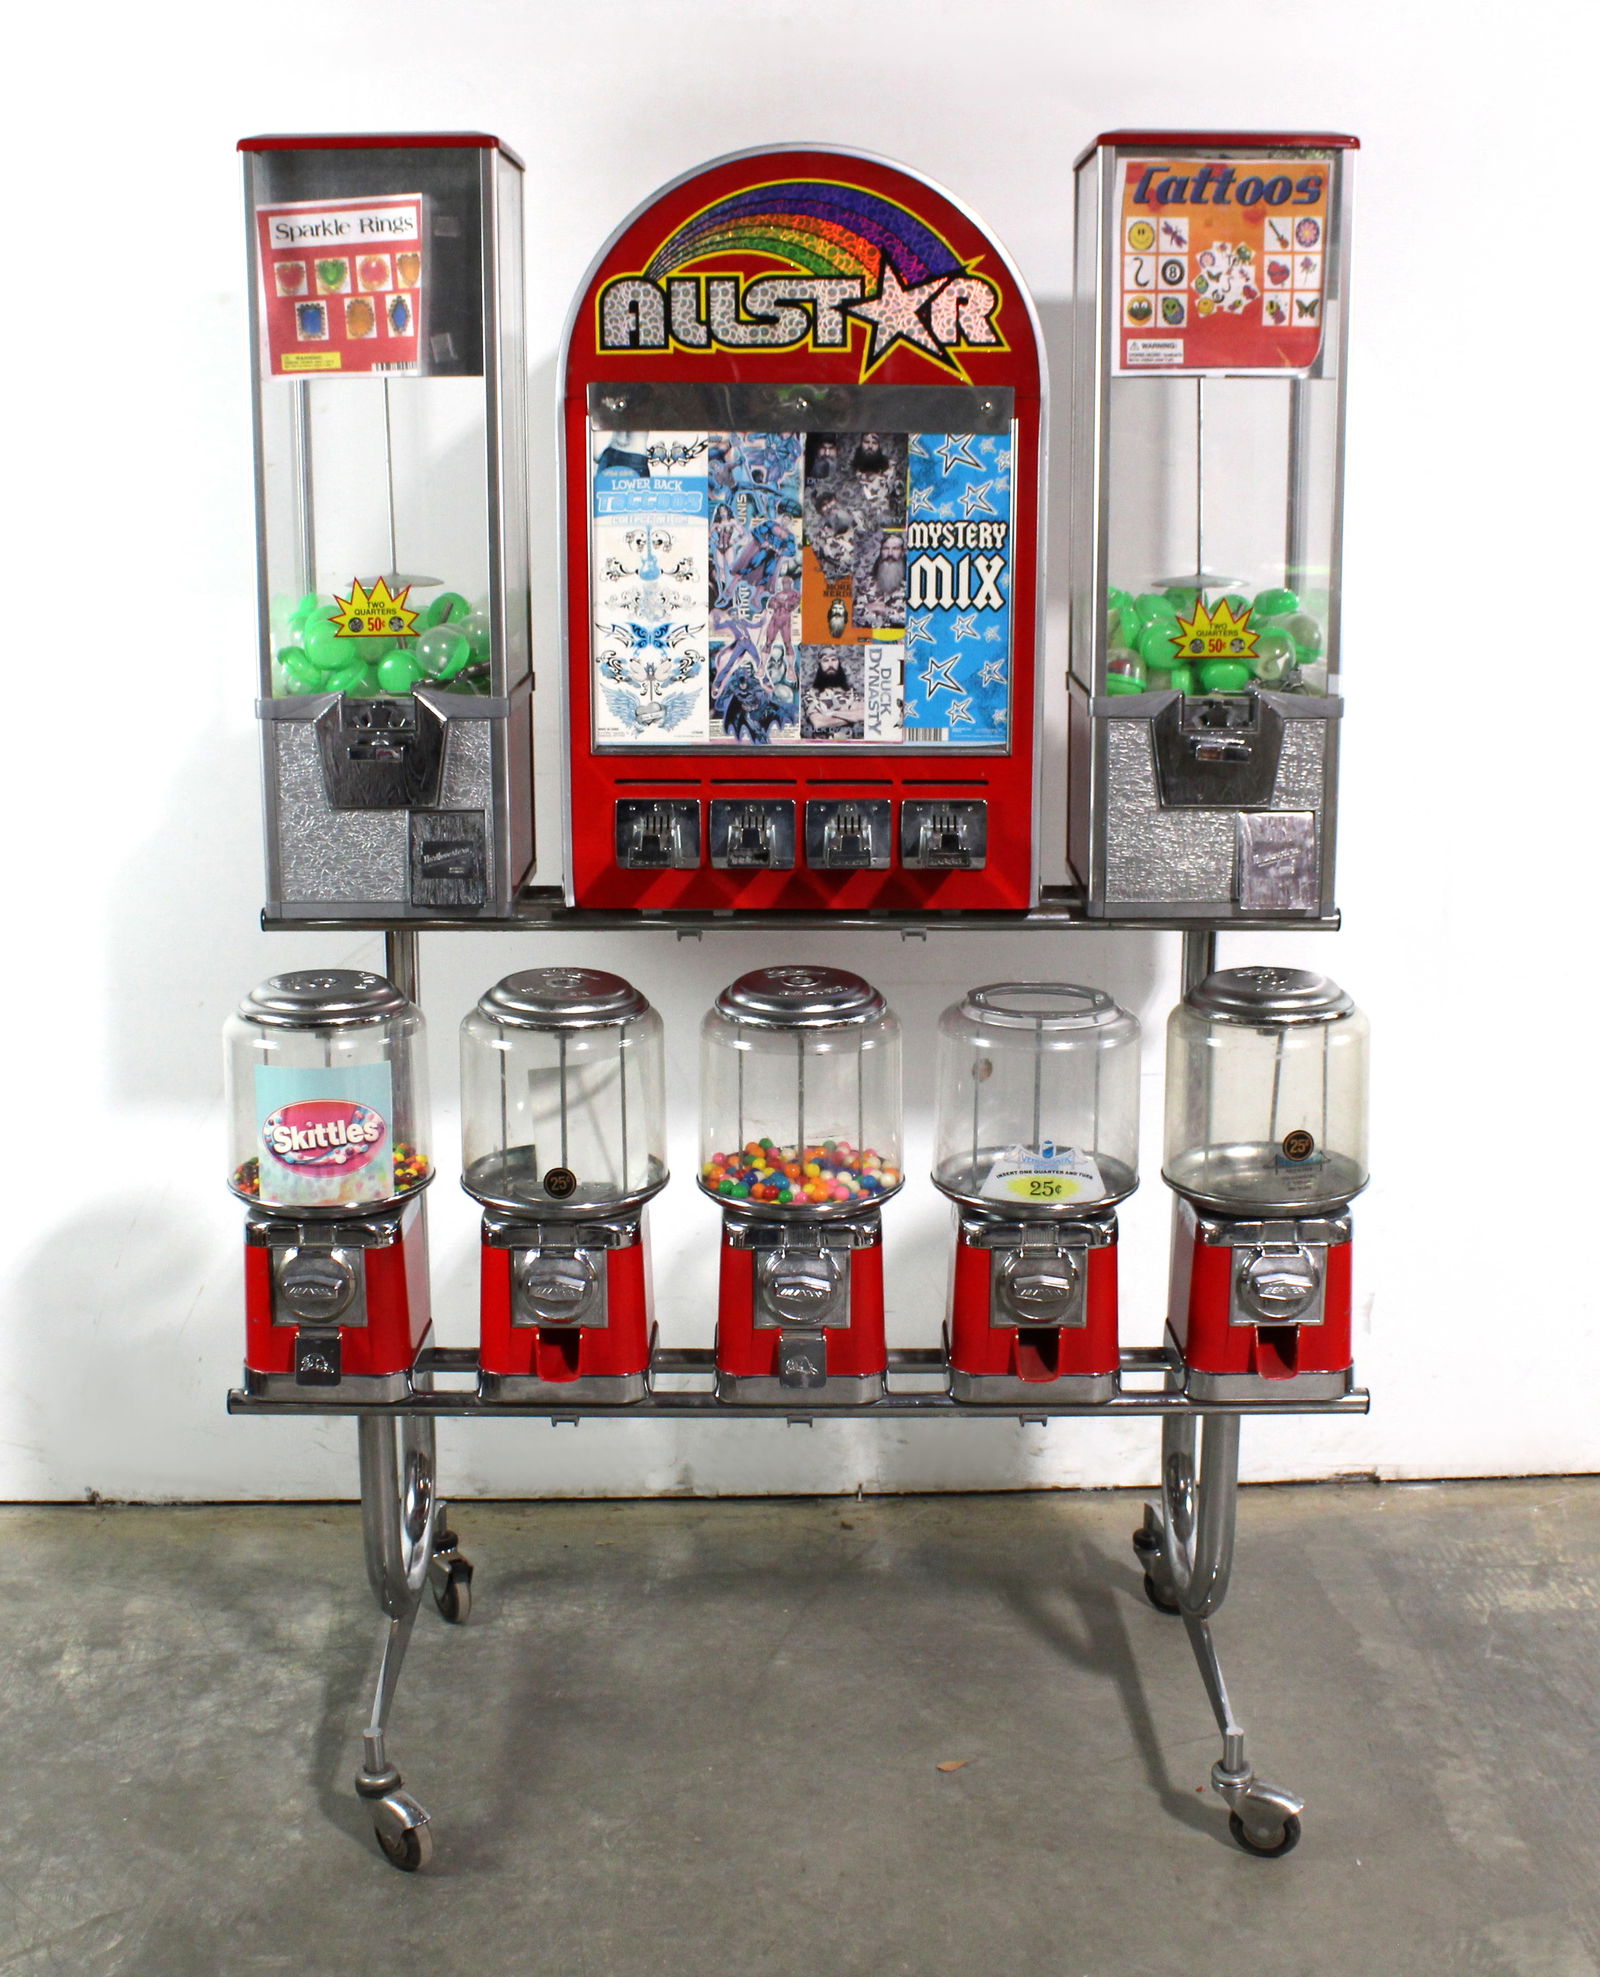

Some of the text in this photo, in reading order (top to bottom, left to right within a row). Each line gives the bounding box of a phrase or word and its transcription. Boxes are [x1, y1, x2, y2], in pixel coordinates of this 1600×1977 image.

[1133, 166, 1323, 206] Tattoos
[275, 211, 414, 243] Sparkle Rings
[612, 479, 683, 491] LOWER BACK
[907, 520, 1007, 551] MYSTERY
[907, 553, 1007, 613] MIX
[354, 608, 398, 616] QUARTERS
[366, 601, 385, 609] TWO
[367, 617, 386, 632] 50¢
[1210, 623, 1228, 631] TWO
[1208, 638, 1227, 653] 50¢
[868, 648, 882, 736] DYNASTY
[880, 668, 892, 716] DUCK
[272, 1119, 380, 1154] Skittles
[996, 1170, 1018, 1179] INSERT
[1030, 1180, 1062, 1197] 25¢
